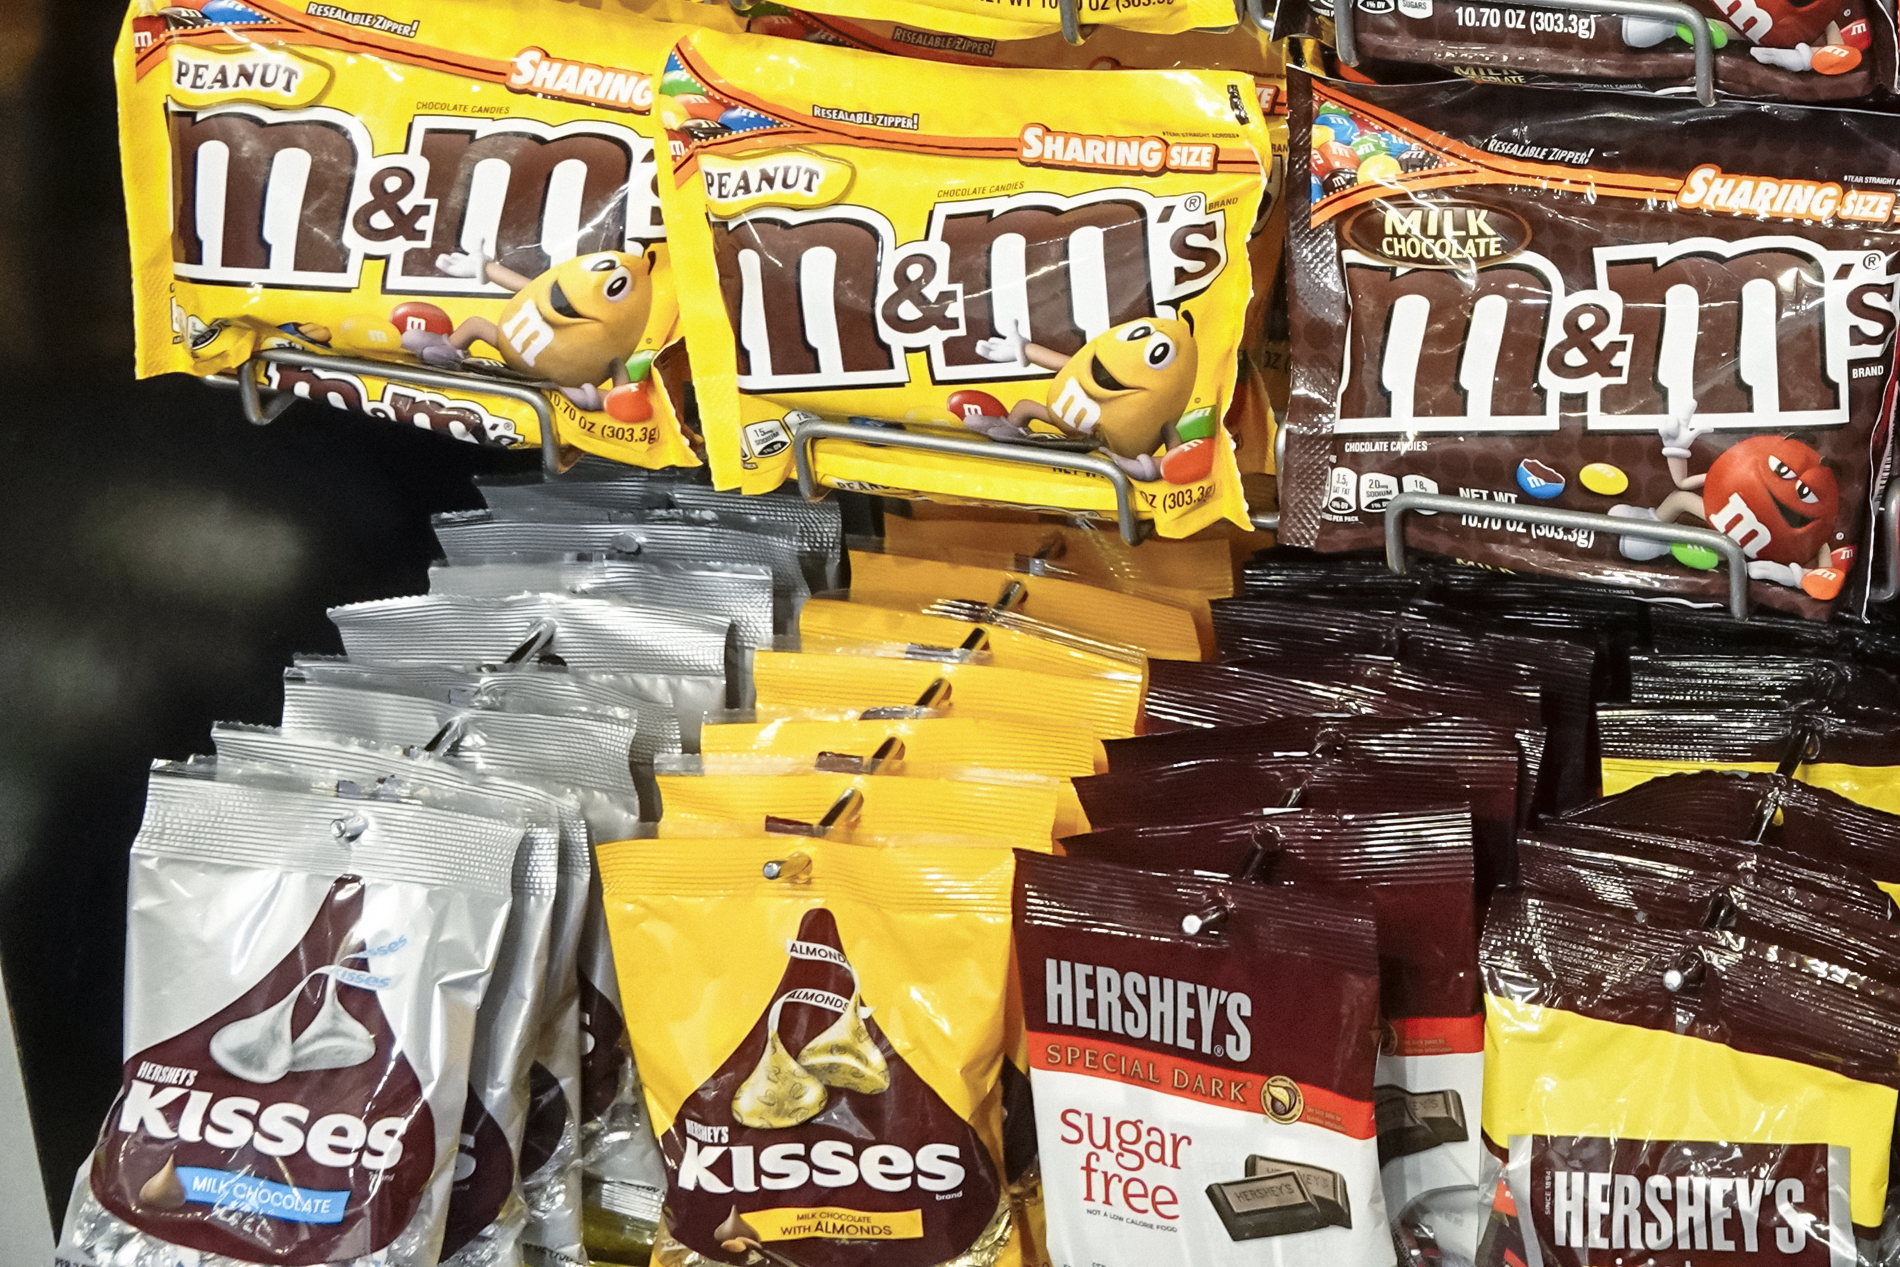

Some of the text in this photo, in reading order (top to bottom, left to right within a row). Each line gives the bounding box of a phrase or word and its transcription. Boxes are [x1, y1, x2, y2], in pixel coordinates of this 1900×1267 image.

[1454, 7, 1501, 27] 10.70
[1505, 11, 1526, 29] OZ
[176, 60, 299, 94] PEANUT
[511, 50, 652, 106] SHARING
[813, 106, 918, 129] RESEALABLE ZIPPER!
[1020, 129, 1214, 169] SHARING SIZE
[1681, 170, 1891, 221] SHARING SIZE
[1384, 209, 1491, 236] MILK
[1382, 234, 1502, 259] CHOCOLATE
[1045, 958, 1252, 1062] HERSHEY'S
[136, 1061, 198, 1087] HERSHEY'S
[1046, 1042, 1247, 1105] SPECIAL DARK
[1060, 1108, 1191, 1172] sugar
[191, 1174, 331, 1216] MILK CHOCOLATE
[1081, 1153, 1180, 1222] free
[781, 1225, 811, 1235] WITH
[796, 1211, 872, 1224] MILK CHOCOLATE
[1555, 1171, 1806, 1250] HERSHEY'S
